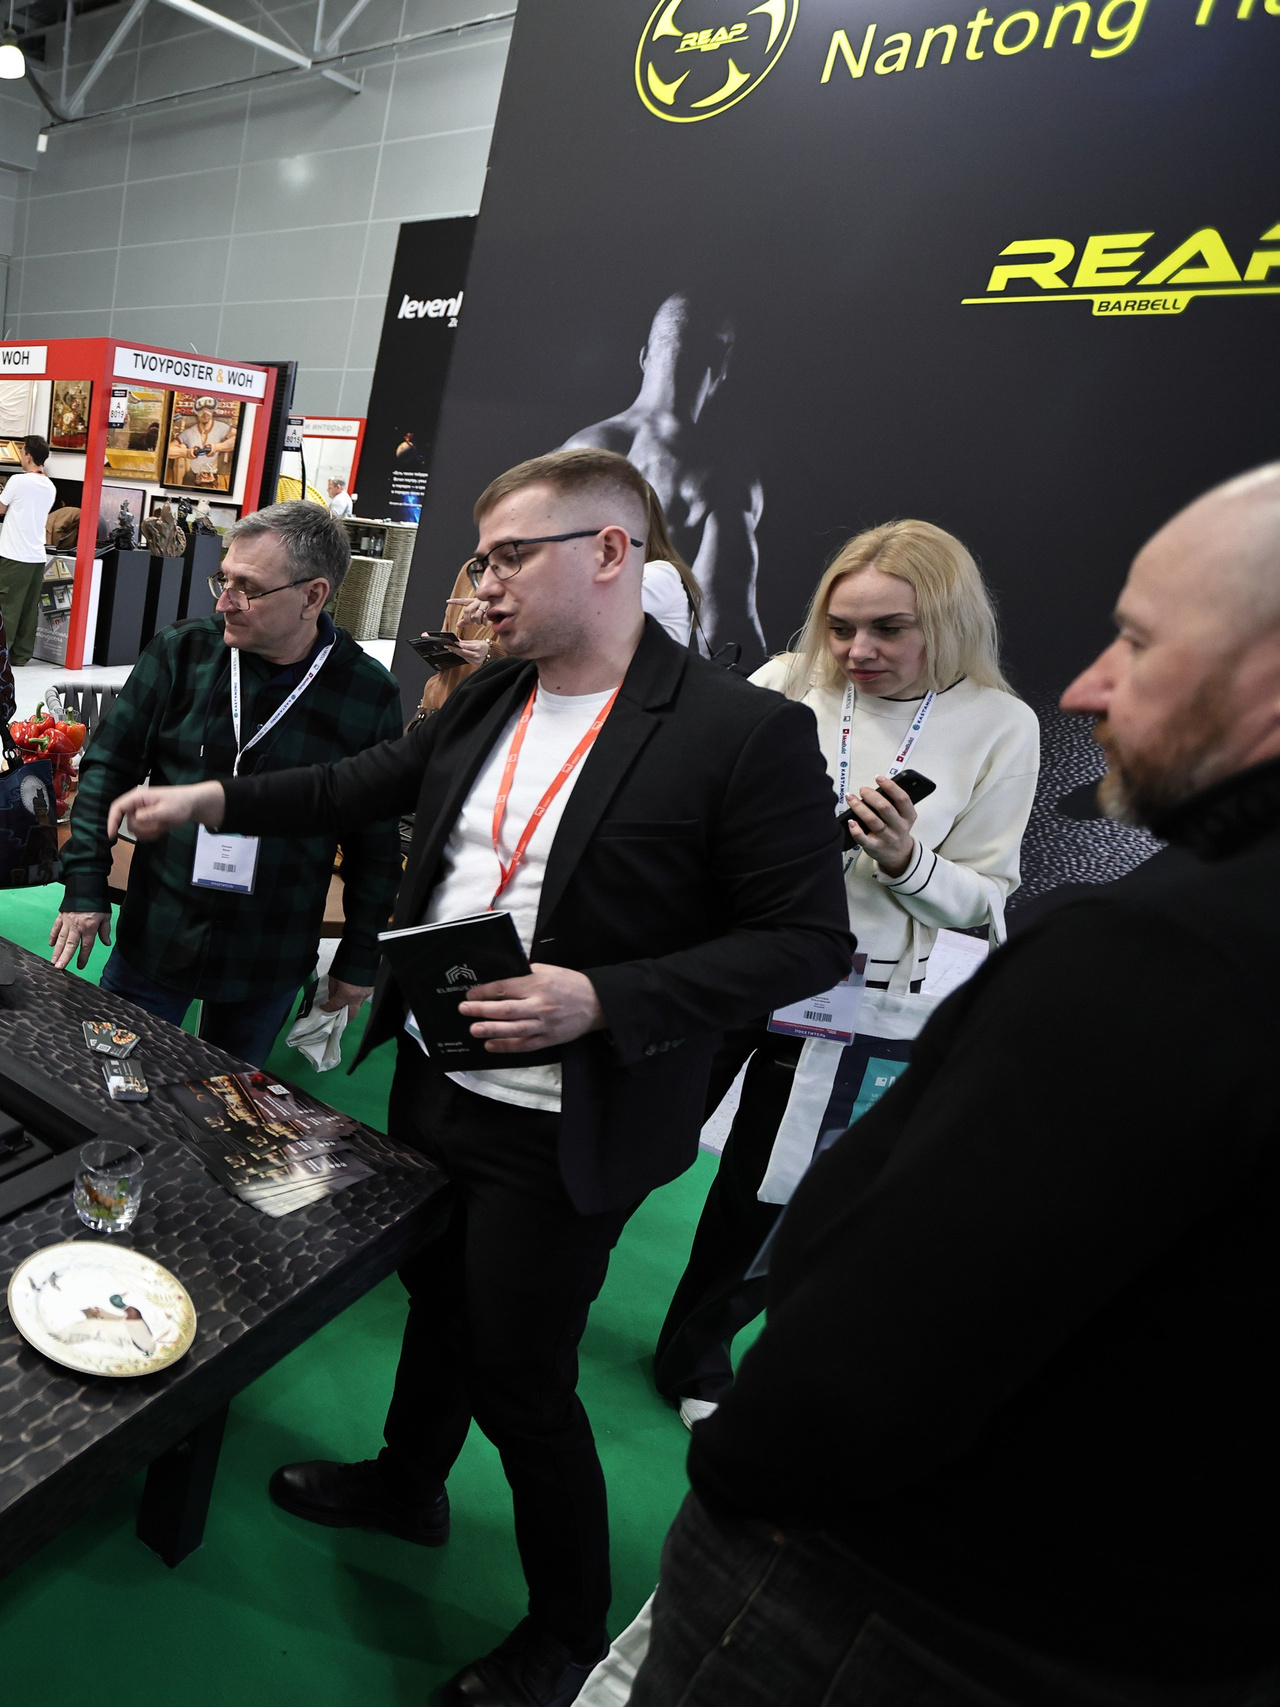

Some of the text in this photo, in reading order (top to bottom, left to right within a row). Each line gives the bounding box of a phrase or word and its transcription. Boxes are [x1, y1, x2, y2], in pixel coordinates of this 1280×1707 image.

[680, 22, 748, 49] REAP
[820, 0, 1151, 84] Nantong
[1097, 298, 1181, 313] BARBELL
[2, 351, 30, 366] WOH
[133, 353, 254, 389] TVOYPOSTER & WOH
[312, 424, 352, 433] интерьер
